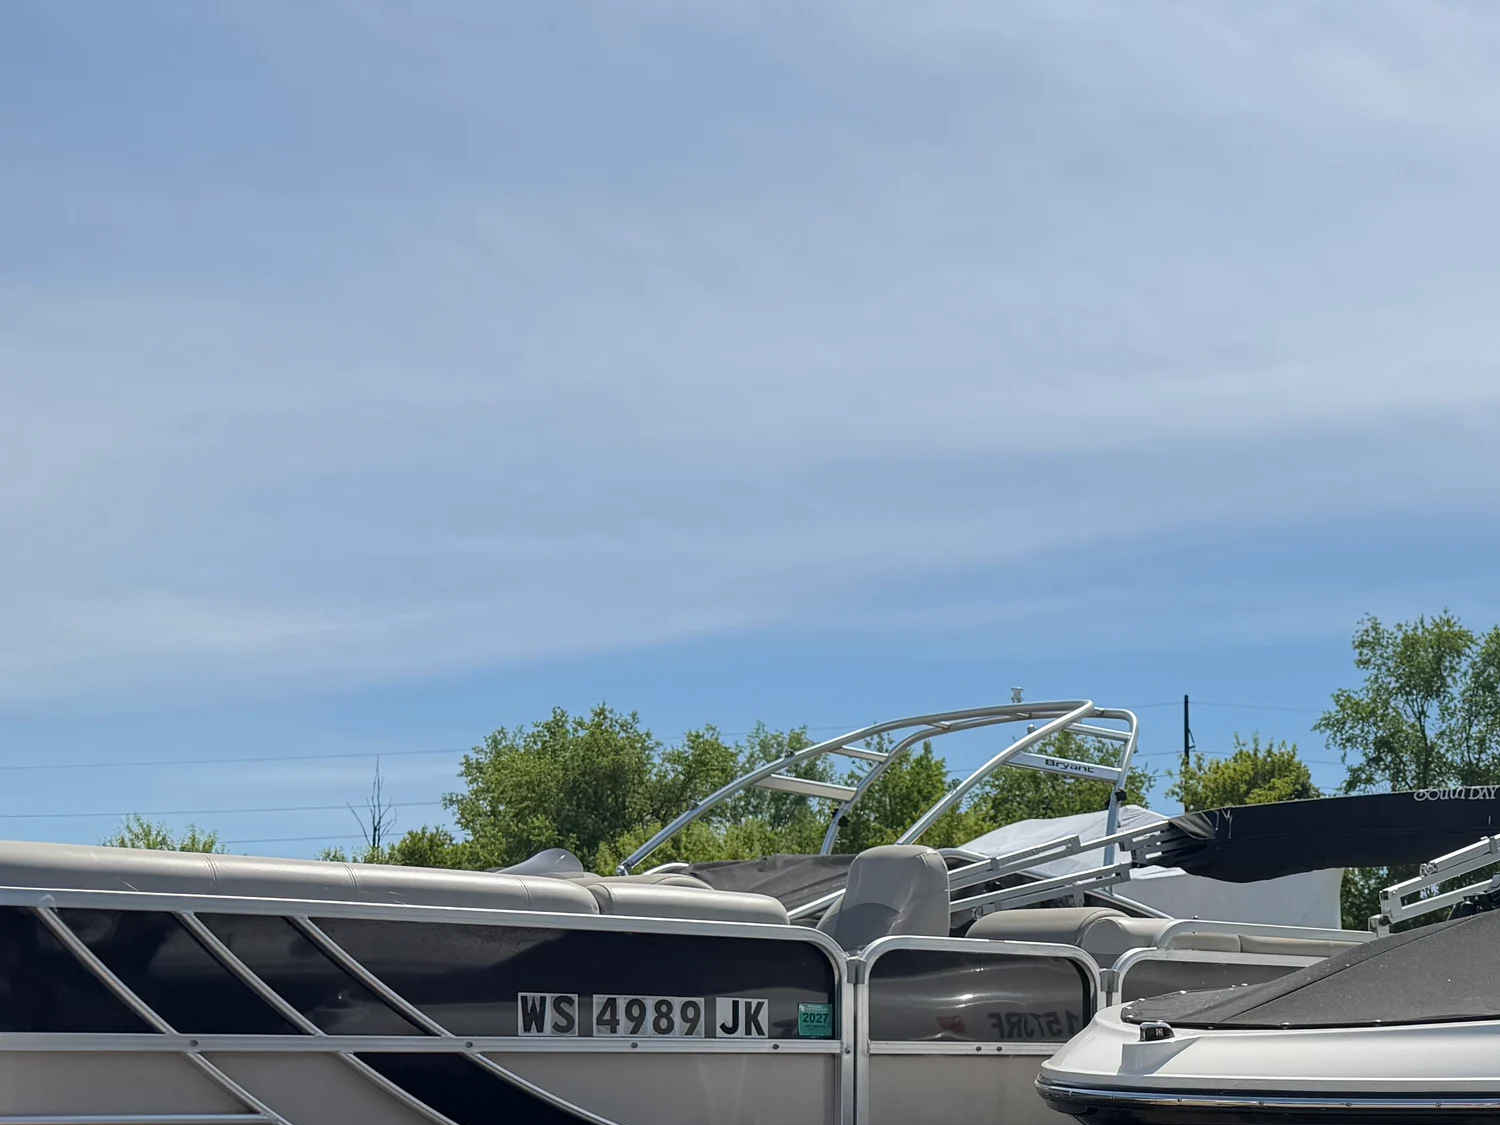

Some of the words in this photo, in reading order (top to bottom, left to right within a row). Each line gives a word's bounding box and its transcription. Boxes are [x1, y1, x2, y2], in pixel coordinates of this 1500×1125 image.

[1045, 759, 1094, 773] Bryant
[520, 994, 576, 1034] WS
[595, 997, 701, 1036] 4989
[719, 999, 766, 1037] JK
[802, 1012, 829, 1024] 2027
